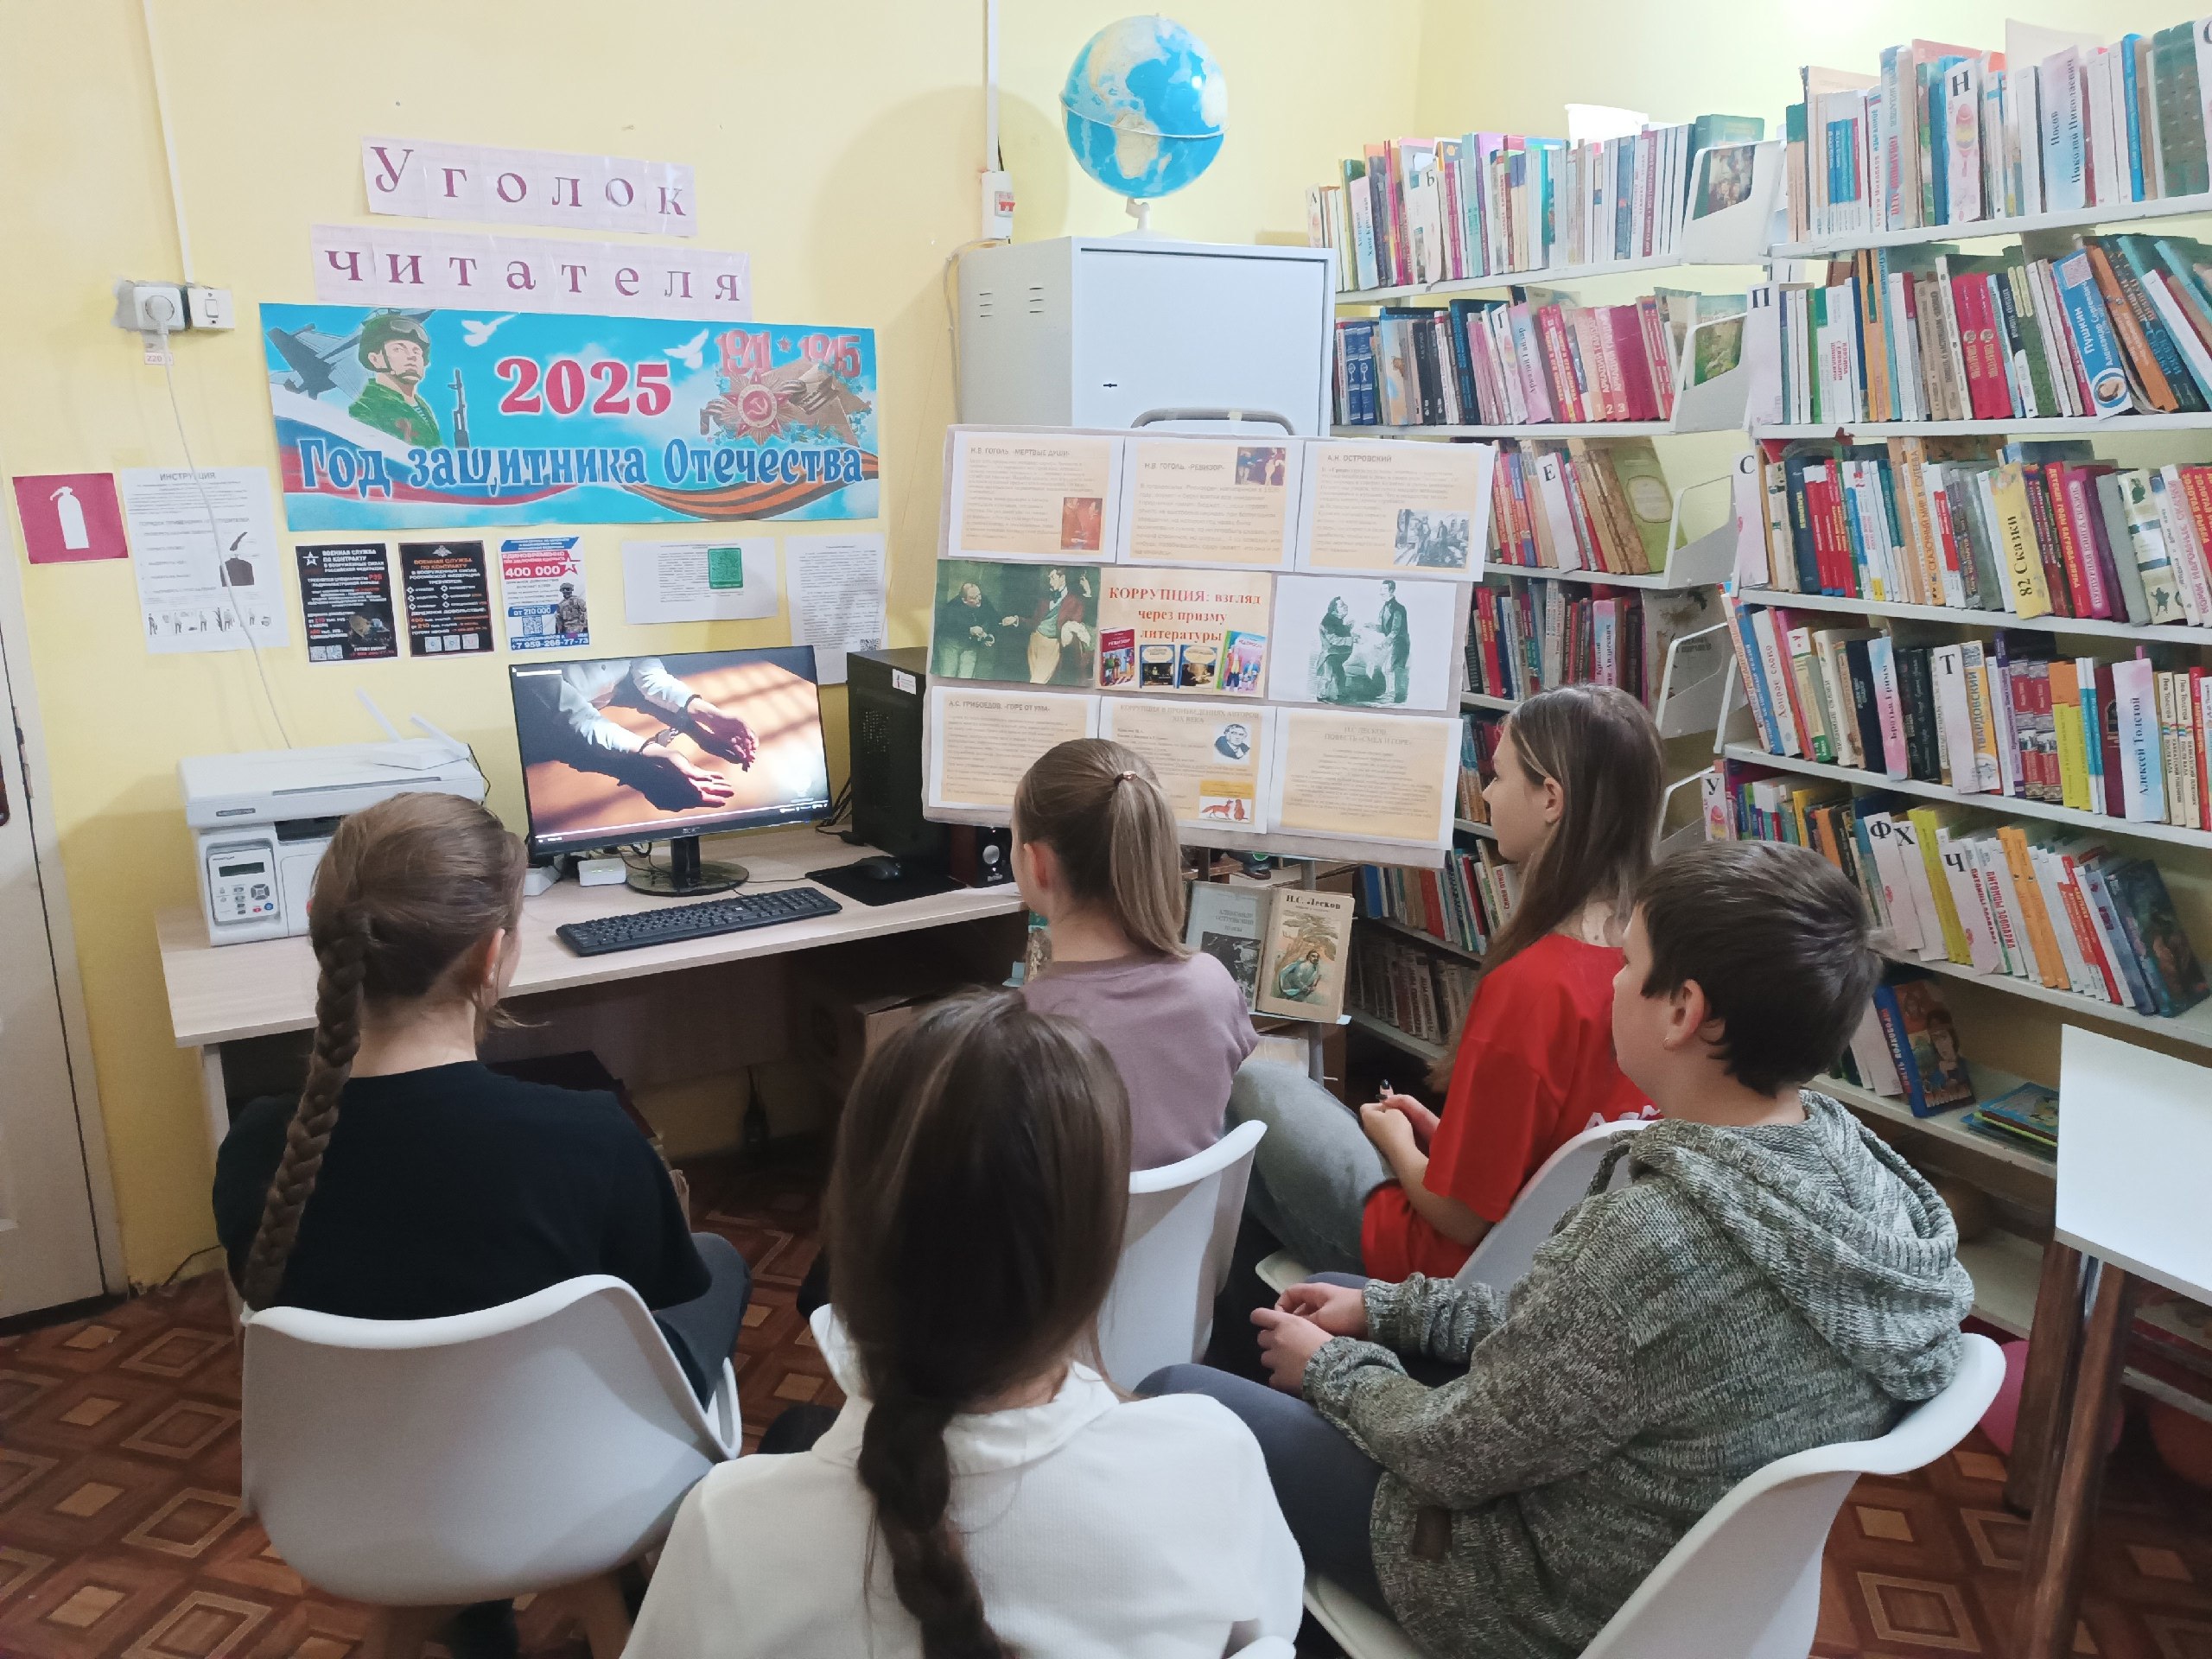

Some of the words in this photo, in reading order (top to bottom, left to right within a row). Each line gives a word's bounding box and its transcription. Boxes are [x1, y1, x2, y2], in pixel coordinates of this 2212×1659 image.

[1951, 69, 1971, 98] Н
[2067, 58, 2078, 130] Николаевич
[2050, 111, 2060, 146] Носов
[2071, 132, 2081, 184] Николай
[369, 145, 688, 217] Уголок
[325, 248, 741, 301] читателя
[2082, 280, 2100, 323] Сергеевич
[1589, 316, 1601, 350] ГАЙДАР
[2075, 306, 2094, 355] Пушкин
[2093, 324, 2113, 366] Александр
[715, 330, 772, 378] 1941
[797, 333, 861, 378] 1945
[1609, 350, 1621, 391] АРКАДИЙ
[495, 357, 674, 416] 2025
[1597, 351, 1610, 393] АРКАДИЙ
[1605, 404, 1613, 415] 2
[1618, 403, 1625, 412] 3
[296, 437, 391, 499] Год
[407, 441, 647, 498] защитника
[663, 437, 864, 486] Отечества
[1343, 454, 1392, 463] ОСТРОВСКИЙ
[1542, 463, 1555, 482] Е
[1739, 454, 1756, 474] С
[1911, 449, 1924, 487] СУТЕЕВА
[159, 472, 216, 481] ИНСТРУЦИЯ
[2183, 473, 2198, 512] ЗОЛОТАЯ
[1918, 499, 1929, 518] МИР
[2071, 486, 2085, 520] СКАЗОК
[1920, 519, 1936, 570] СКАЗОЧНЫЙ
[2007, 515, 2028, 575] Сказки
[505, 567, 531, 577] 400
[535, 565, 561, 575] 000
[2017, 578, 2032, 596] 82
[1109, 587, 1210, 602] КОРРУПЦИЯ:
[1215, 594, 1262, 605] взгляд
[1138, 610, 1174, 622] через
[1178, 611, 1227, 626] призму
[1140, 628, 1223, 644] литературы
[1765, 645, 1777, 674] слово
[1938, 652, 1955, 675] Т
[1967, 670, 1986, 751] ТВАРДОВСКИЙ
[2129, 697, 2144, 747] Толстой
[2163, 692, 2171, 719] Толстой
[1705, 777, 1720, 796] У
[2133, 748, 2148, 796] Алексей
[1869, 820, 1891, 840] Ф
[1893, 826, 1916, 847] Х
[1944, 853, 1967, 873] Ч
[1306, 897, 1341, 910] Лесков
[1986, 871, 2005, 908] ПИТОМЦЫ
[1997, 910, 2016, 949] ЗООПАРКА
